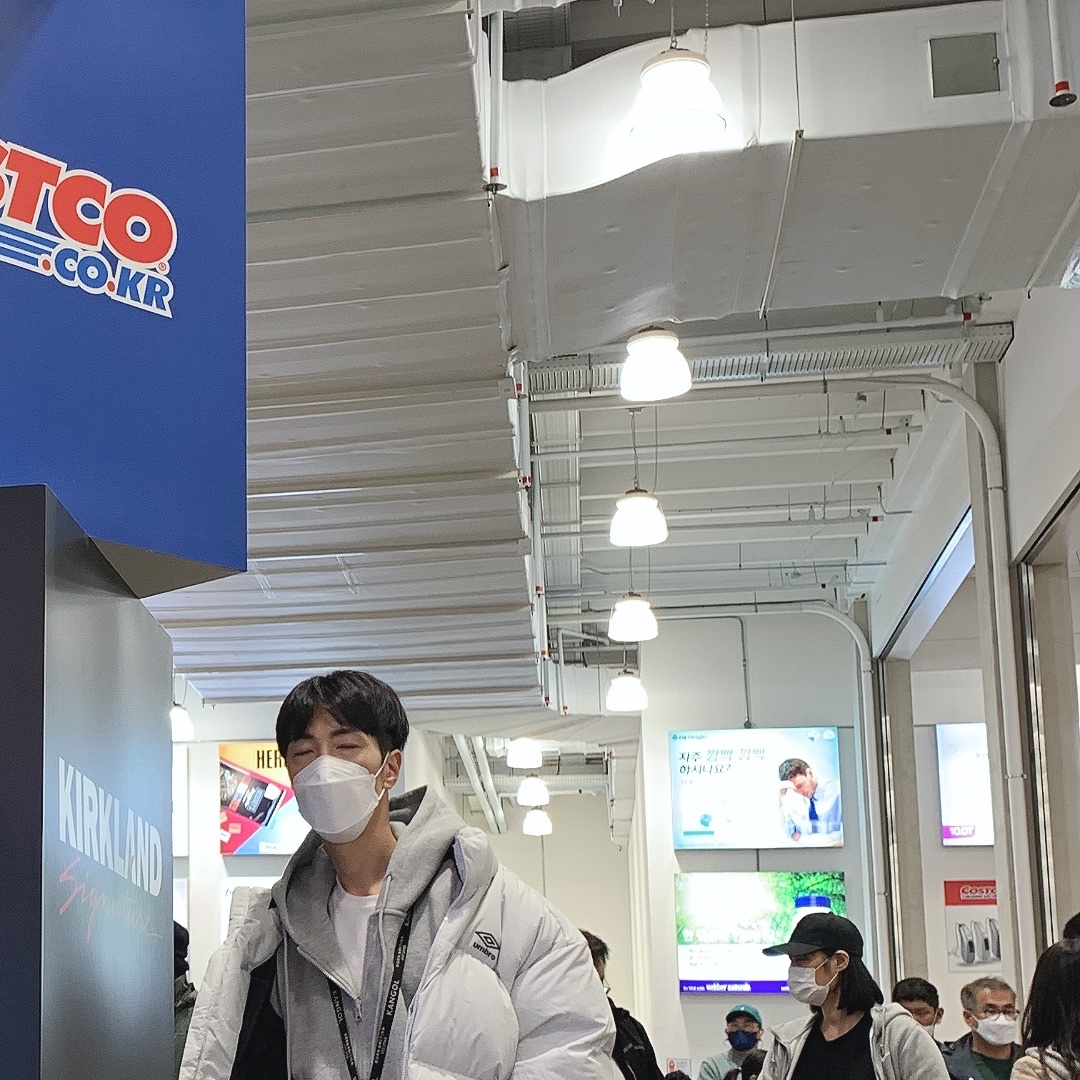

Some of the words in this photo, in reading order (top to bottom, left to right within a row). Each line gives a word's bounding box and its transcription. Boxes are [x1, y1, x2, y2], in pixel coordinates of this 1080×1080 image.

[40, 248, 172, 313] .CO.KR
[679, 751, 701, 762] 자주
[679, 763, 732, 775] 하시나요?
[59, 756, 163, 897] KIRKLAND
[472, 941, 496, 961] umbro
[386, 979, 400, 1016] KANGOL
